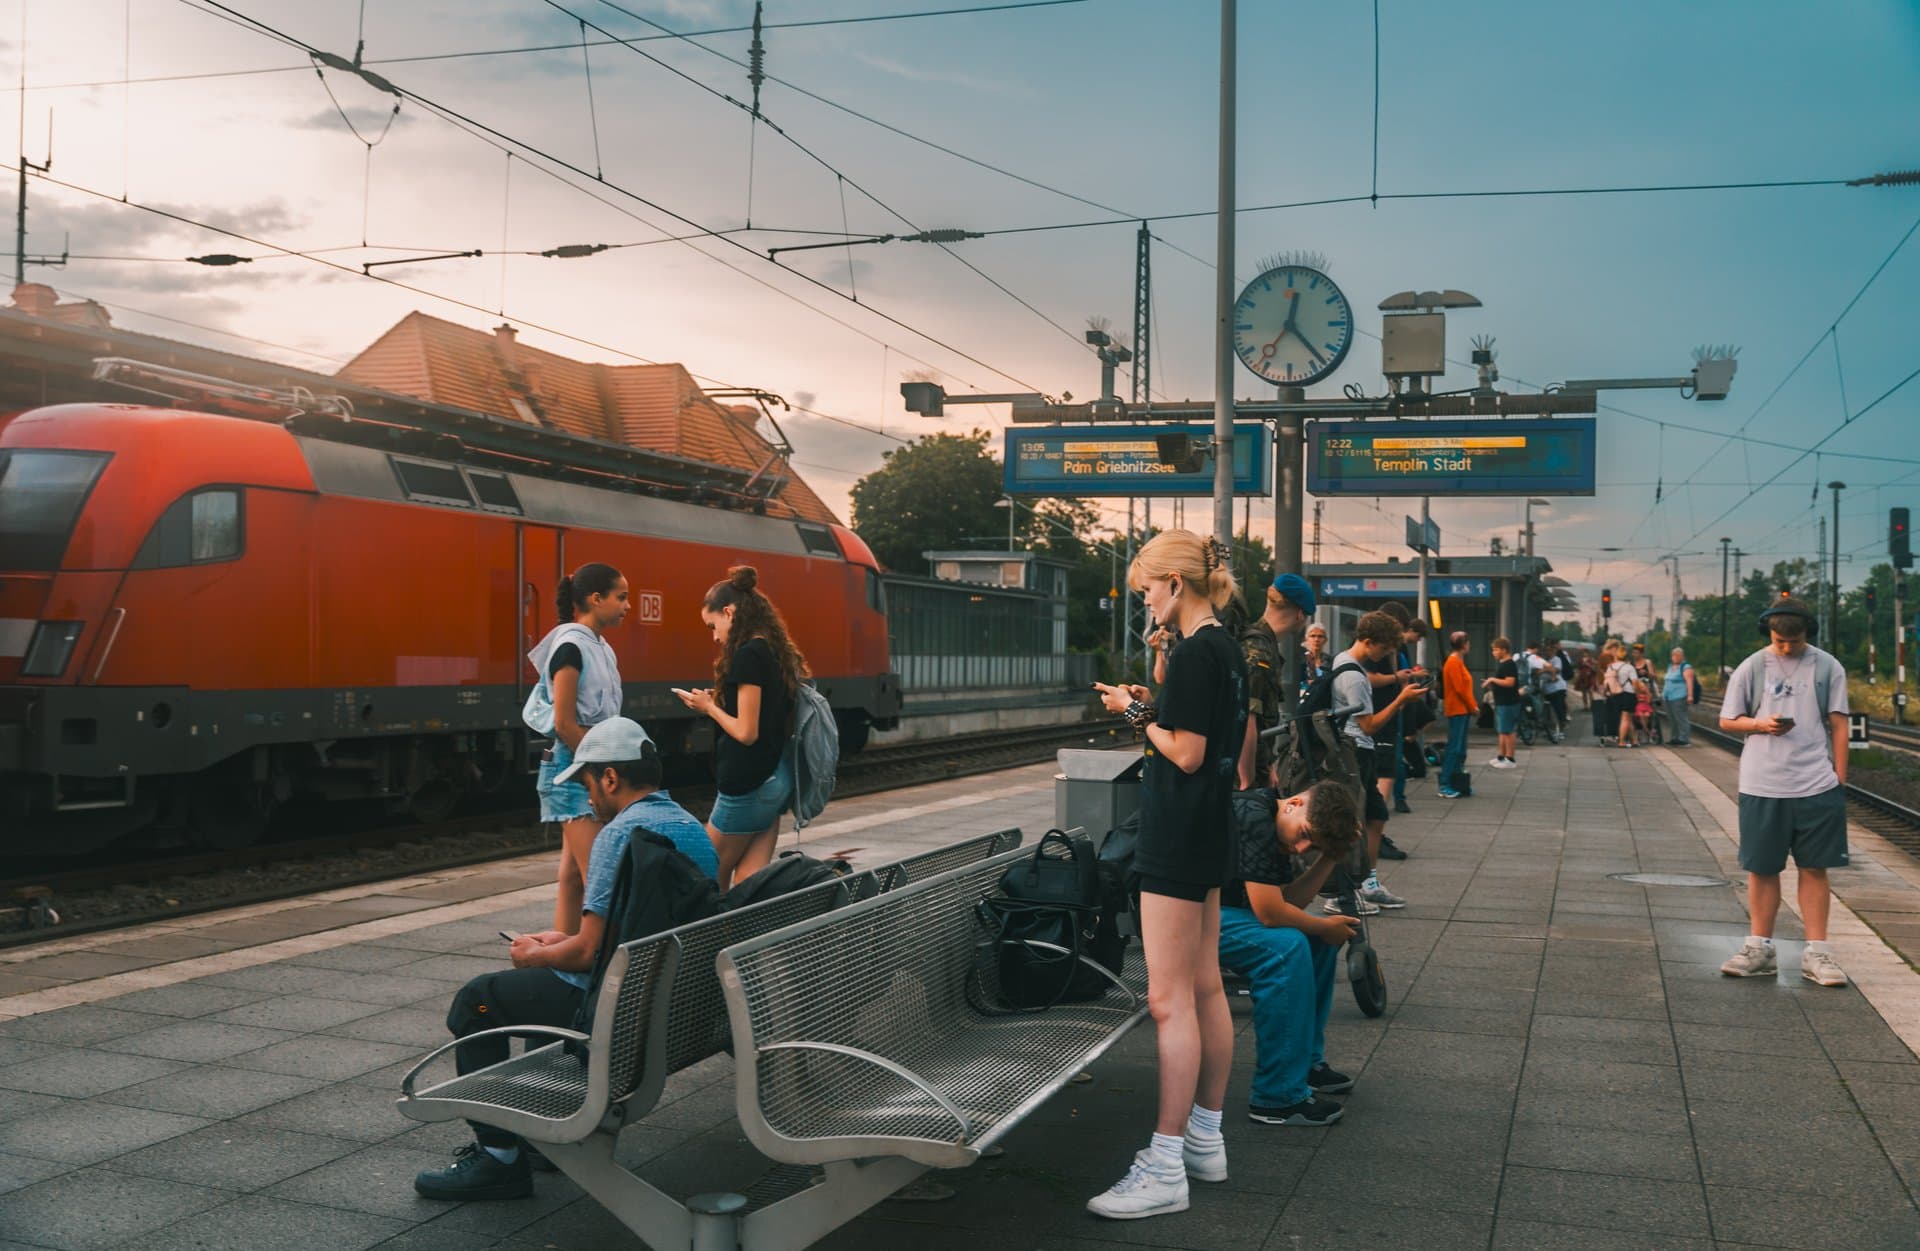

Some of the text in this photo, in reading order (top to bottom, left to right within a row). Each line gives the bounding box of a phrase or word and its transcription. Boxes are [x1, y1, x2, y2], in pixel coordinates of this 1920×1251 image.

[1063, 460, 1176, 474] Pdm Griebnitzsee
[1373, 458, 1472, 474] Templin Stadt
[642, 596, 660, 618] DB
[1848, 716, 1866, 738] H
